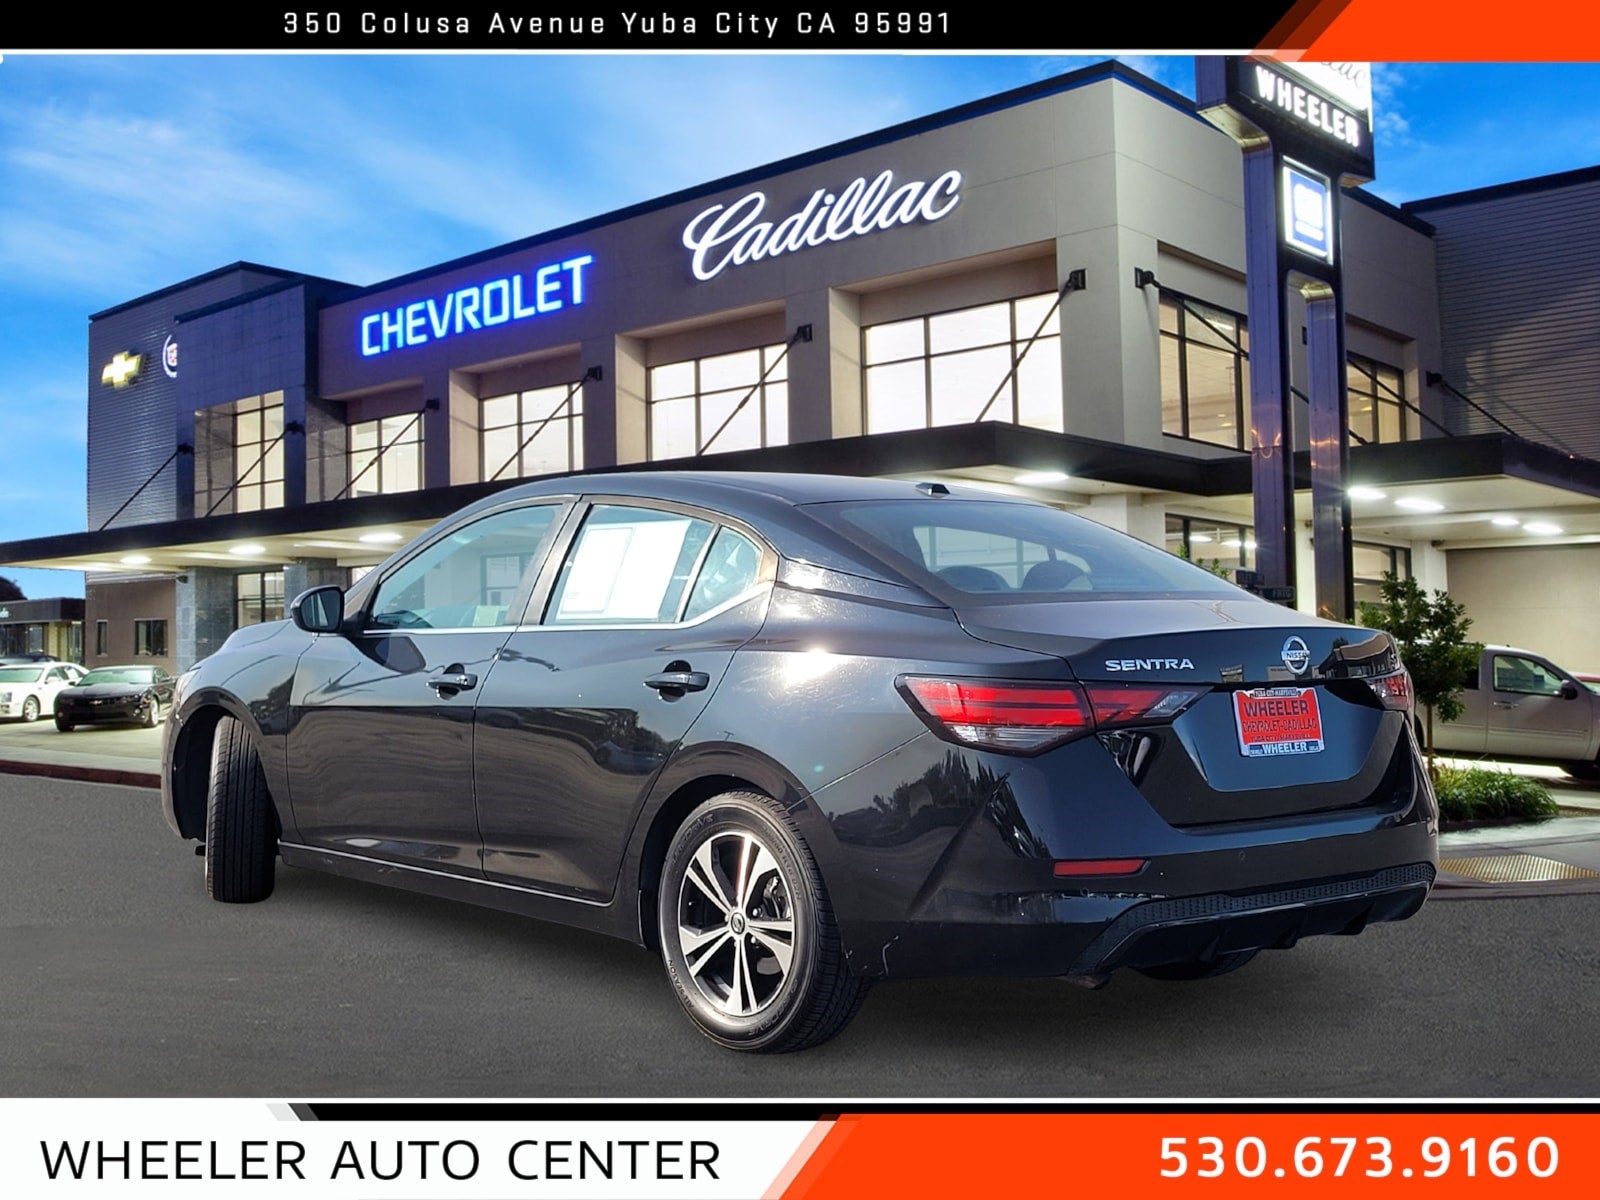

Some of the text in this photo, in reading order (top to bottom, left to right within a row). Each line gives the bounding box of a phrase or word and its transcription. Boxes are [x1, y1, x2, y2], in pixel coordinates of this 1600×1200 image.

[1255, 65, 1360, 148] WHEELER
[681, 169, 963, 280] Cadillac
[360, 254, 593, 356] CHEVROLET
[1105, 658, 1195, 672] SENTRA
[1243, 699, 1309, 717] WHEELER
[1262, 741, 1308, 755] WHEELER
